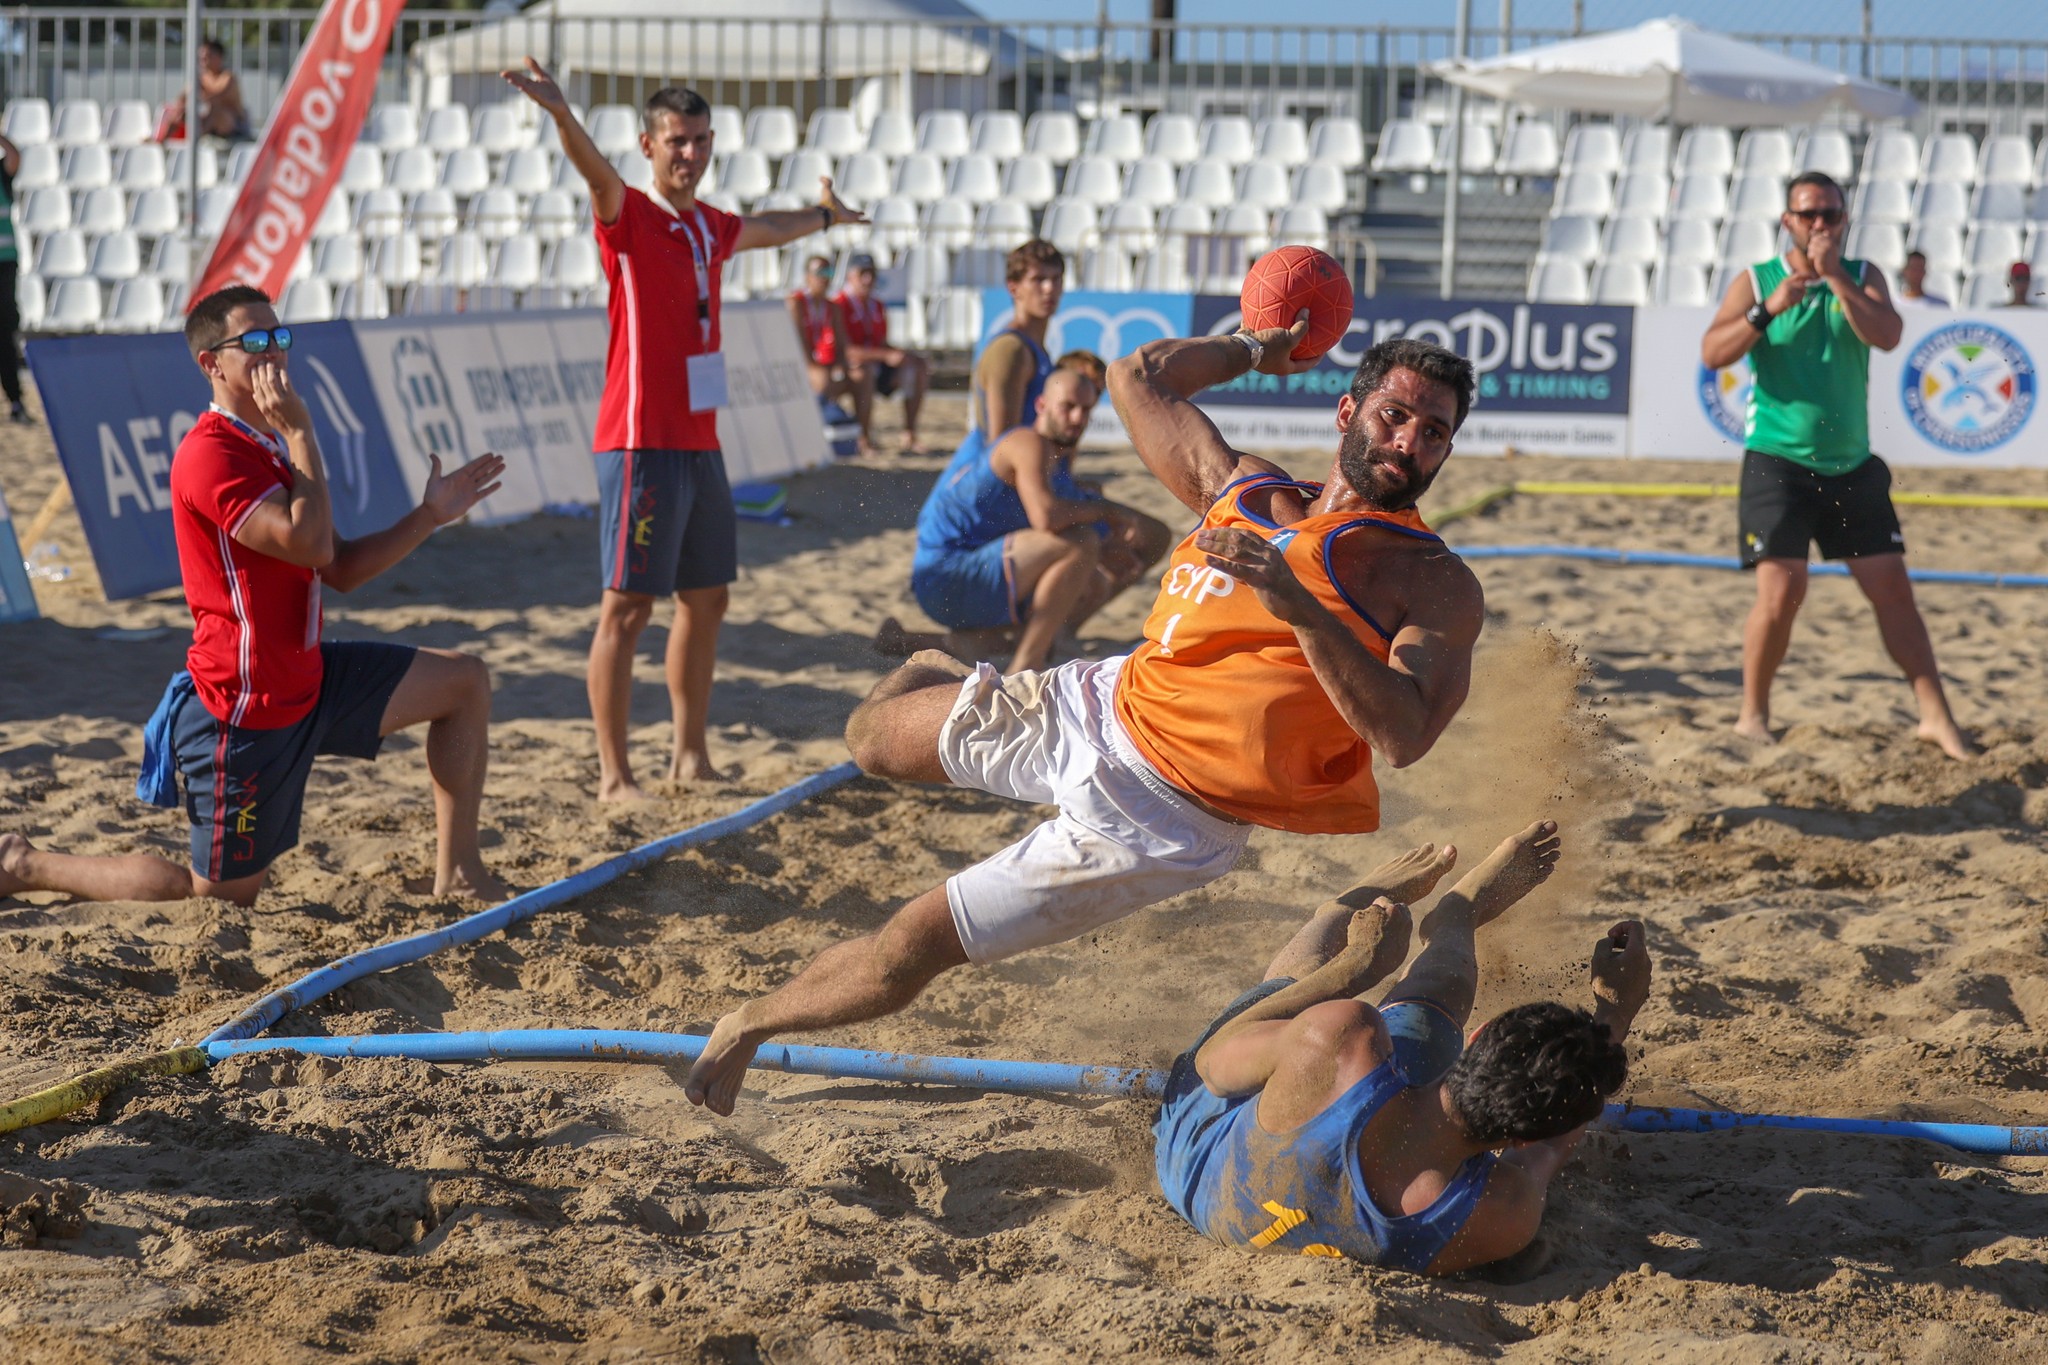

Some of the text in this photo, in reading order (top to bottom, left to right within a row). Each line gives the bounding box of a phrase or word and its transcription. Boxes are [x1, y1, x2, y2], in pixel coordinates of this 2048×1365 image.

[221, 59, 355, 290] vodafon
[1479, 374, 1500, 397] &
[1506, 373, 1610, 400] TIMING
[1167, 562, 1236, 604] CYP
[1160, 613, 1183, 655] 1
